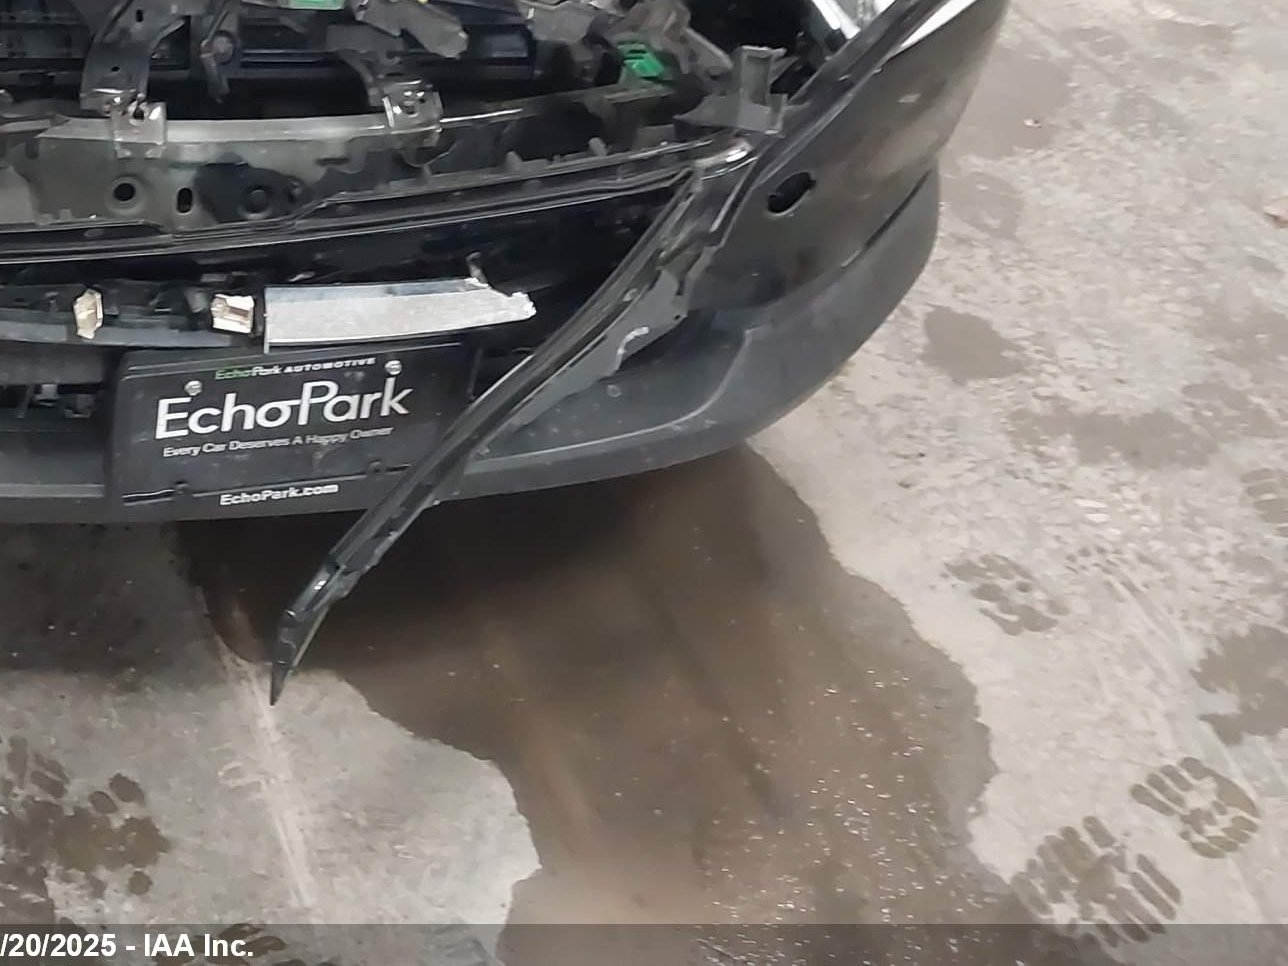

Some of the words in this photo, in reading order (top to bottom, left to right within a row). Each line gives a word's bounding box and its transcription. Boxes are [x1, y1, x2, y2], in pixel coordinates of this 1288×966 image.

[215, 365, 282, 380] EchoPark
[283, 356, 376, 373] AUTOMOTIVE
[155, 376, 414, 439] EchoPark
[163, 445, 201, 457] Every
[202, 442, 227, 453] Car
[229, 437, 290, 451] Deserves
[292, 436, 303, 445] A
[306, 433, 348, 445] Happy
[219, 484, 339, 506] EchoPark.com
